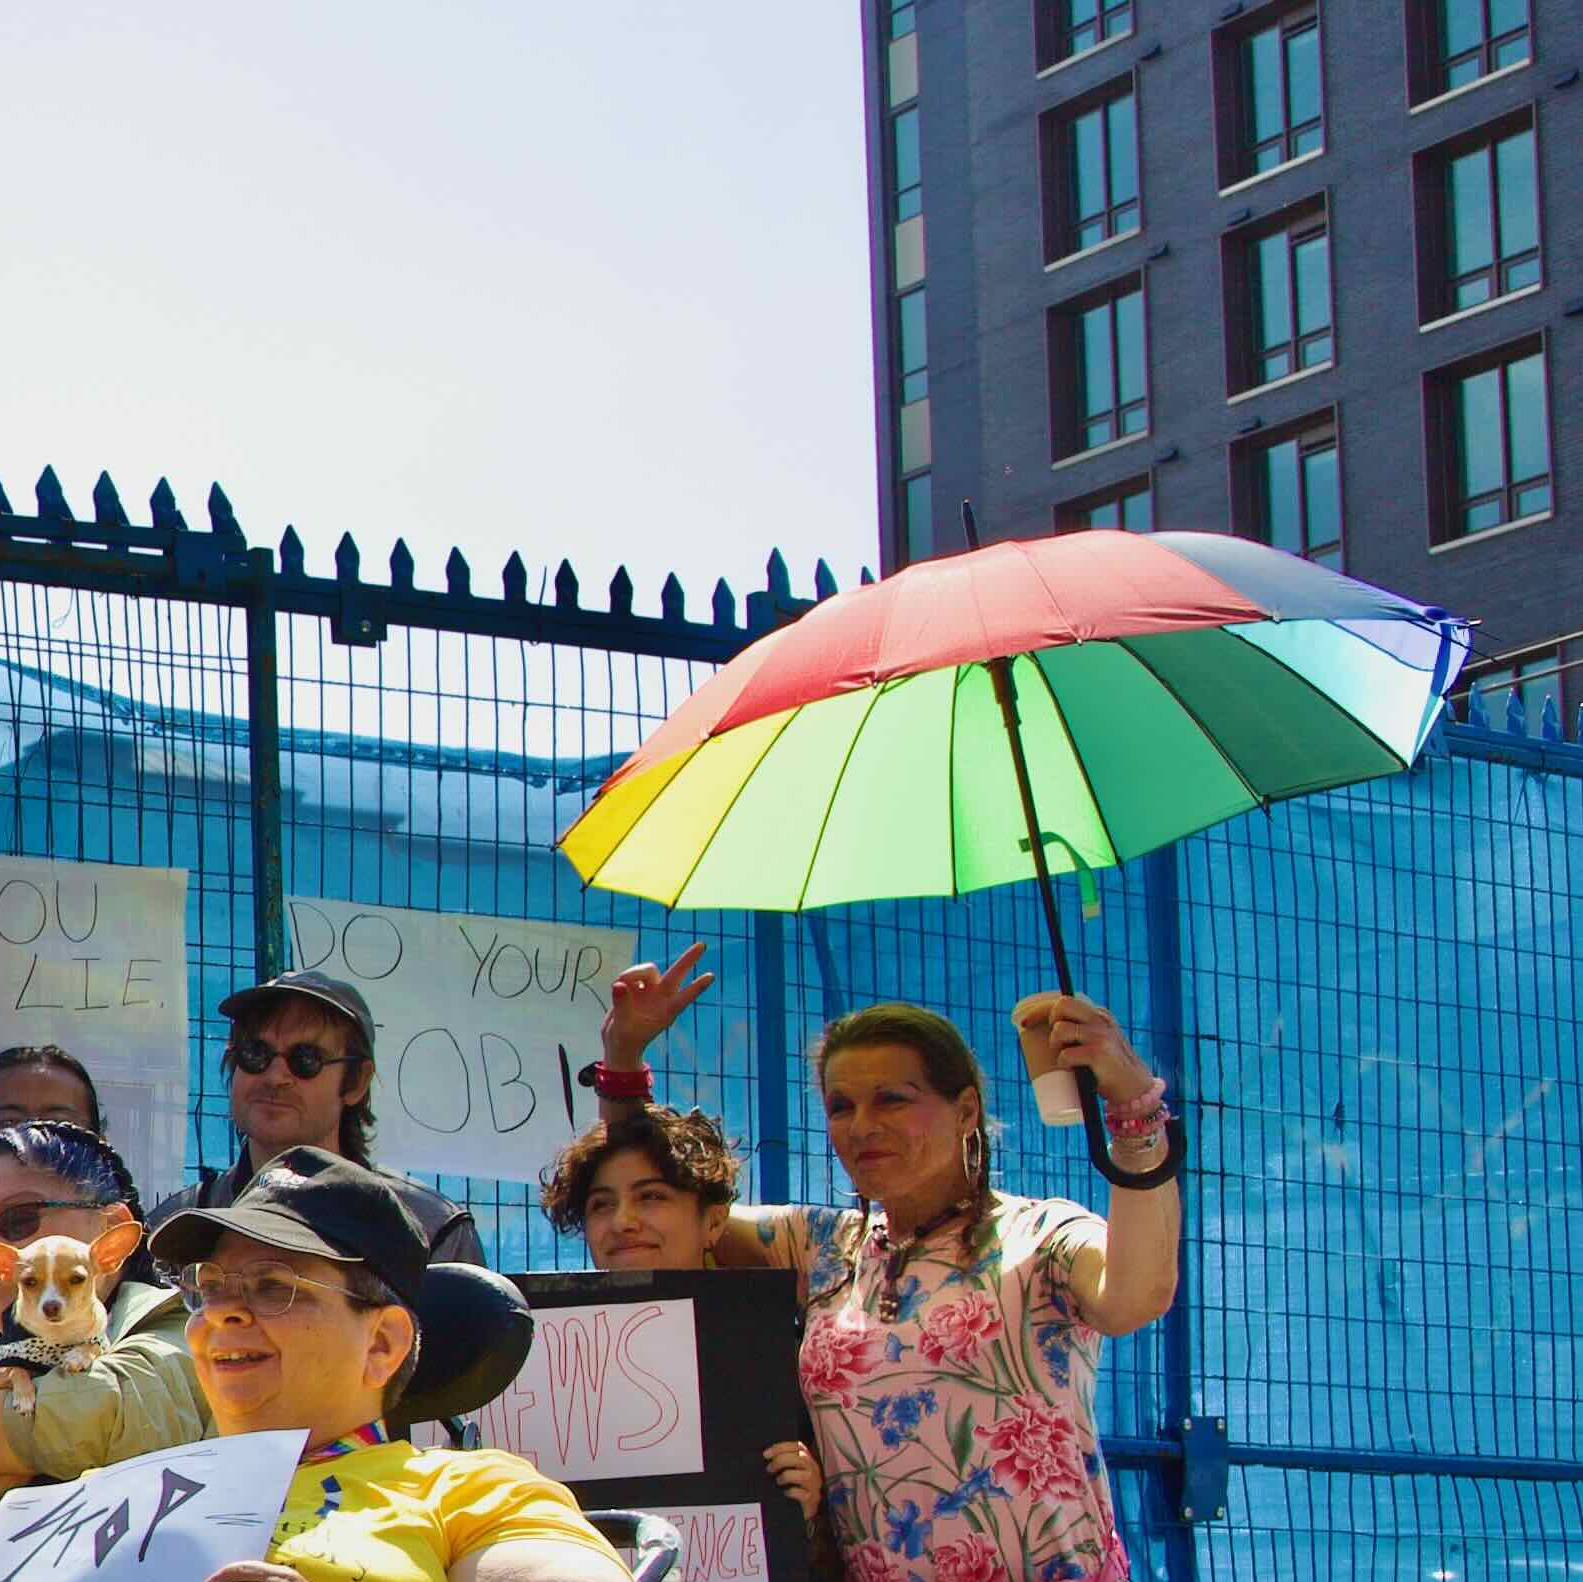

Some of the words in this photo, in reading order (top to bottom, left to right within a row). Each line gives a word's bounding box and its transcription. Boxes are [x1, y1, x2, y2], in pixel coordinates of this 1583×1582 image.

[290, 900, 403, 980] DO
[457, 925, 610, 1012] YOUR
[375, 1023, 577, 1135] OB!
